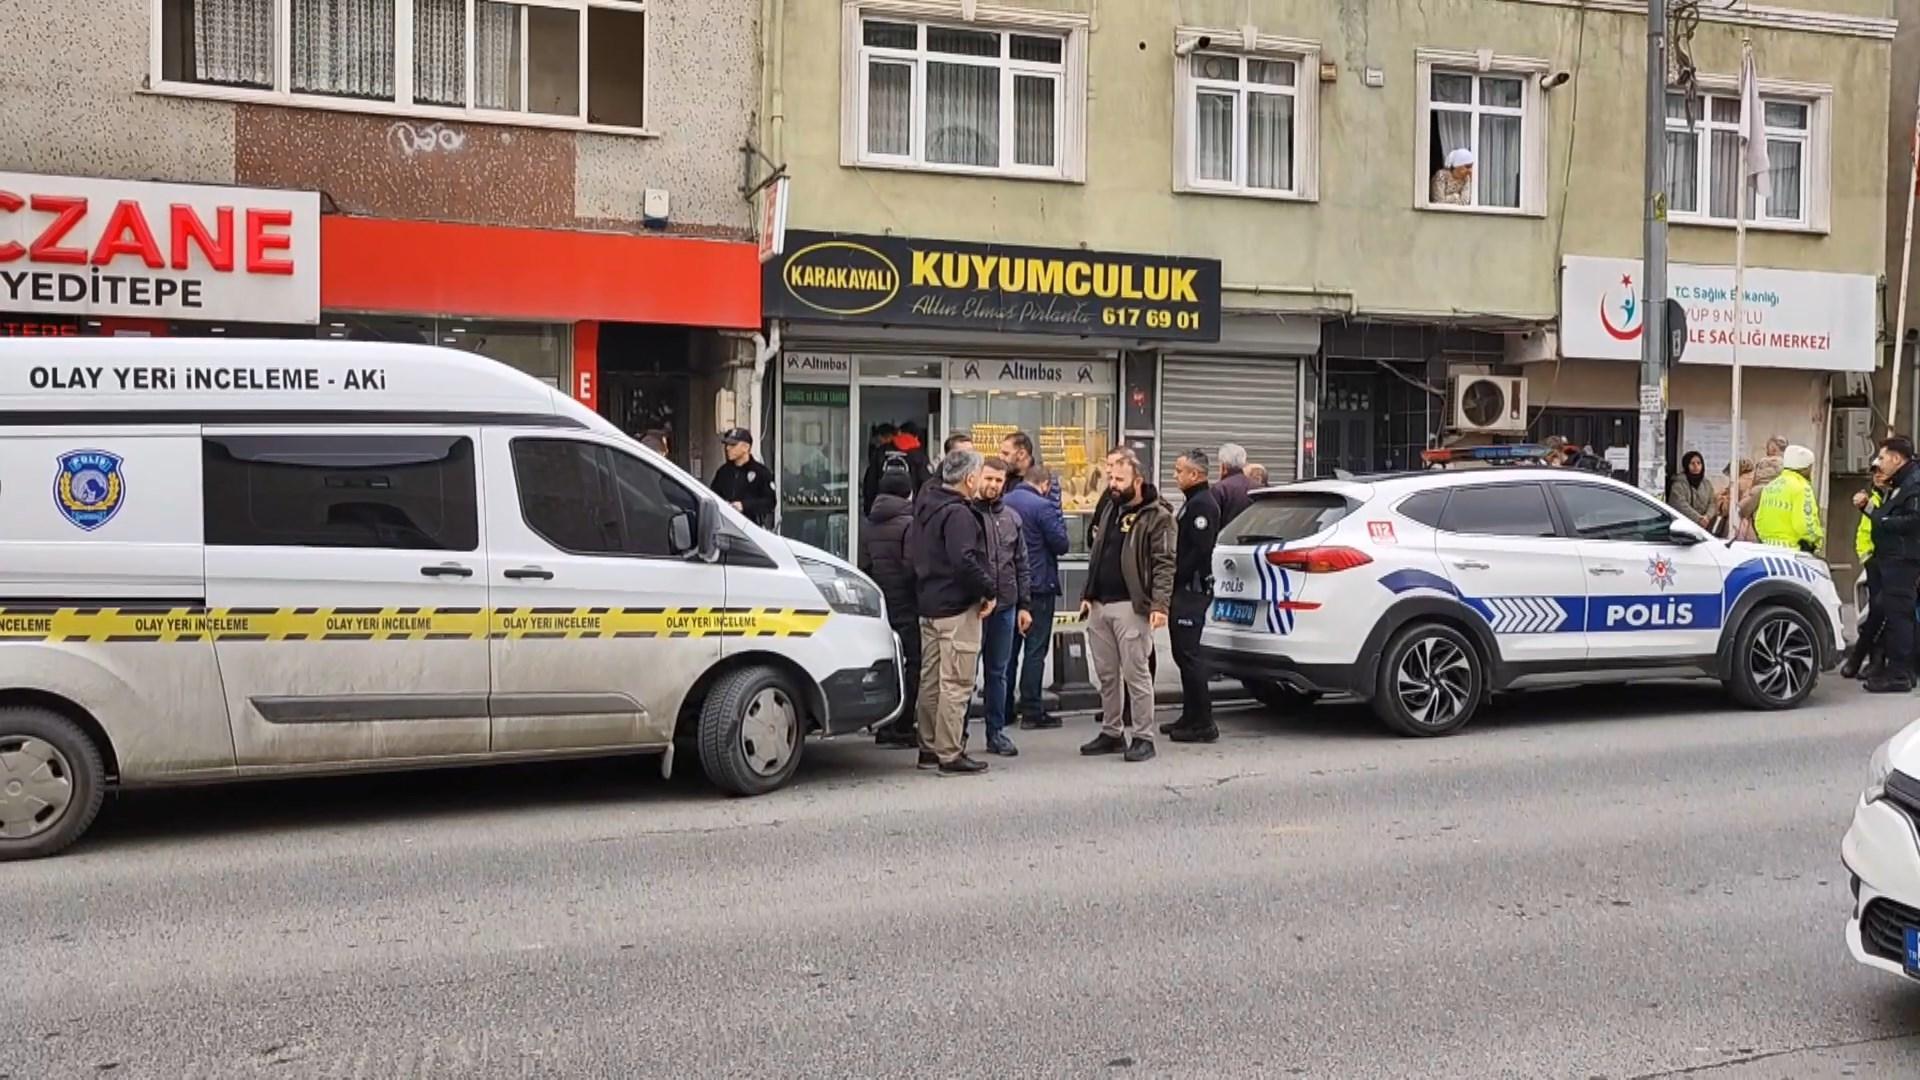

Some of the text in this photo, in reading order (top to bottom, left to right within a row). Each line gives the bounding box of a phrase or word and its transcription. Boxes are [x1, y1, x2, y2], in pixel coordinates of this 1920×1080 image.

[0, 266, 202, 307] YEDİTEPE
[791, 264, 892, 291] KARAKAYALI
[911, 250, 1199, 303] KUYUMCULUK
[1102, 306, 1199, 330] 617 69 01
[1770, 331, 1831, 350] MERKEZİ
[29, 366, 103, 389] OLAY
[580, 372, 591, 399] E
[503, 617, 528, 629] OLAY
[666, 617, 690, 629] OLAY
[1606, 597, 1694, 626] POLİS
[135, 618, 164, 632] OLAY
[326, 617, 353, 631] OLAY
